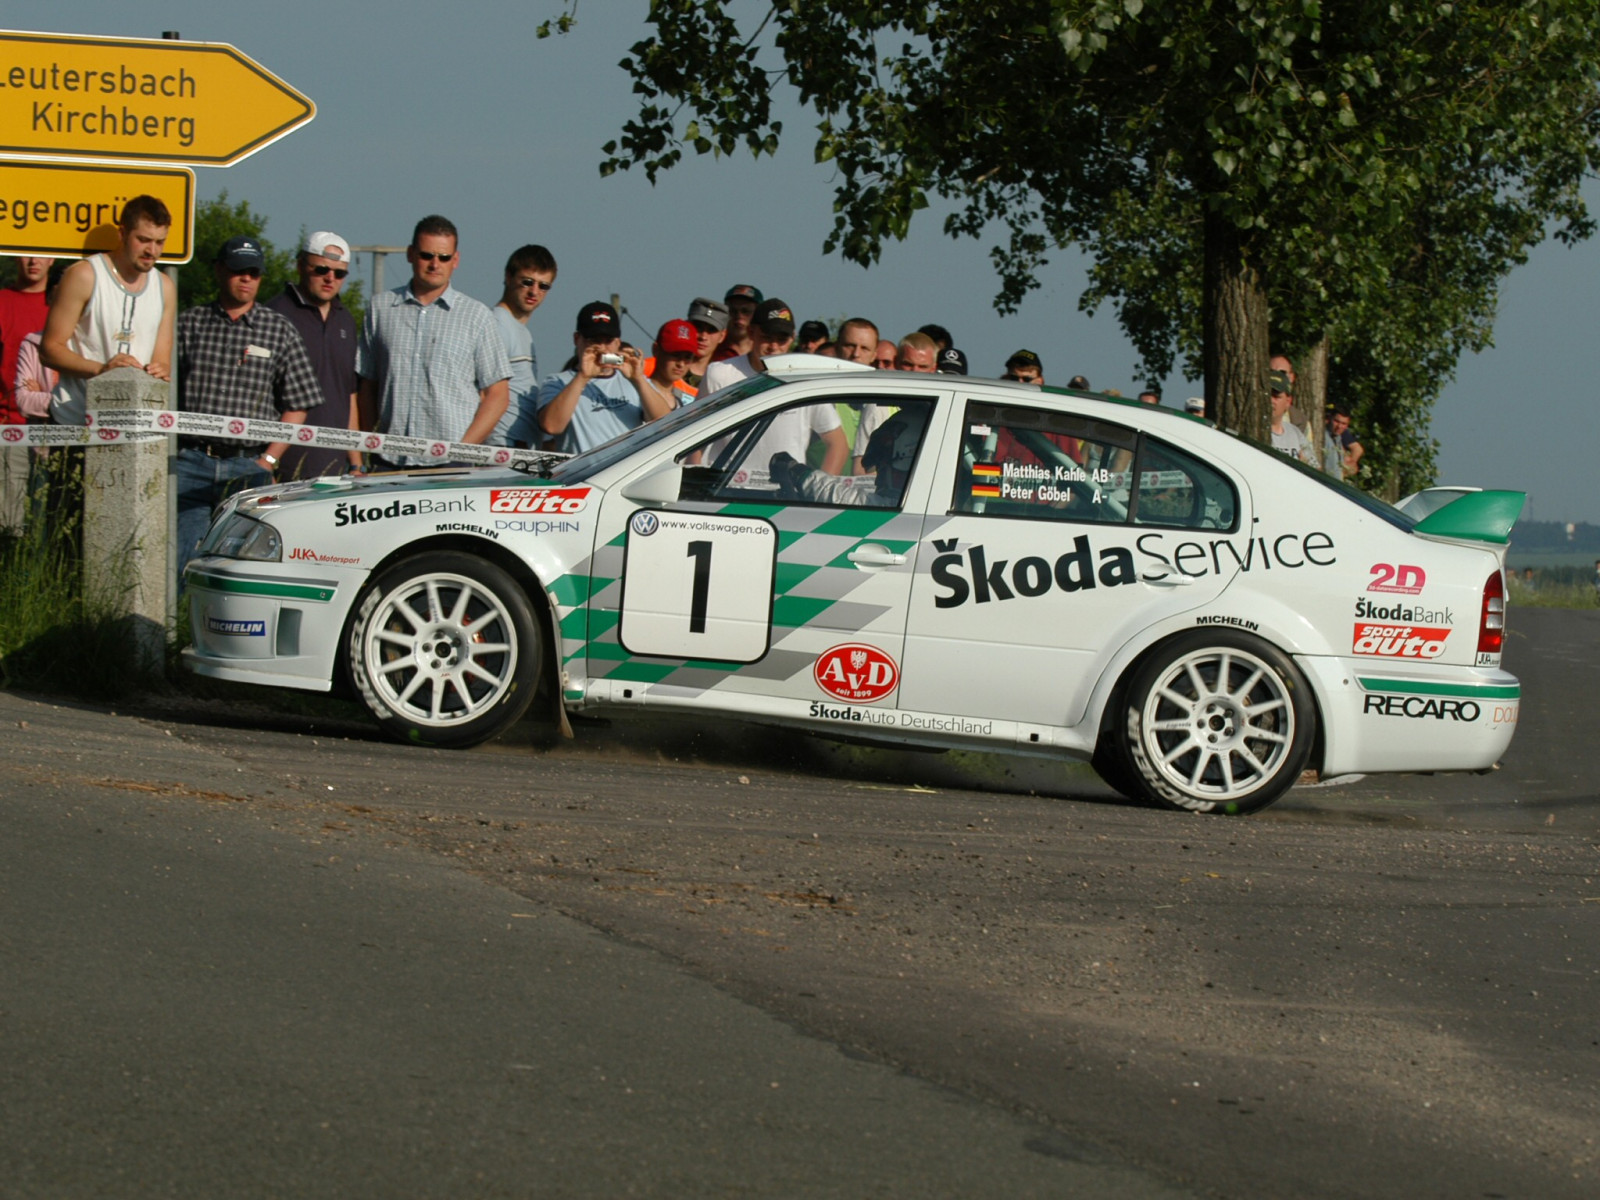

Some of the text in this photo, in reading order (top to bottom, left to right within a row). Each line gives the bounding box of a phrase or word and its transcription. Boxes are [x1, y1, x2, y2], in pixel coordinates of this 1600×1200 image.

[0, 63, 196, 98] eutersbach
[32, 102, 196, 147] Kirchberg
[0, 196, 127, 232] egengrü
[29, 433, 89, 443] tomobilclub
[1002, 463, 1050, 480] Matthias
[1055, 466, 1086, 483] Kahle
[492, 493, 588, 514] auto
[496, 489, 550, 503] sport
[1002, 484, 1033, 500] Peter
[1038, 485, 1071, 502] Göbel
[334, 495, 476, 527] ŠkodaBank
[436, 523, 500, 539] MICHELIN
[660, 518, 769, 536] www.volkswagen.de
[319, 555, 361, 564] Motorsport
[1369, 563, 1426, 587] 2D
[686, 540, 713, 634] 1
[1354, 597, 1454, 624] ŠkodaBank
[210, 621, 263, 632] MICHELIN
[1196, 616, 1259, 632] MICHELIN
[1360, 624, 1413, 638] sport
[1353, 635, 1447, 659] auto
[819, 656, 894, 691] AvD
[835, 687, 872, 698] seit 1899
[809, 701, 992, 736] ŠkodaAuto Deutschland
[1364, 694, 1480, 722] RECARO
[1128, 705, 1216, 812] MICHELIN
